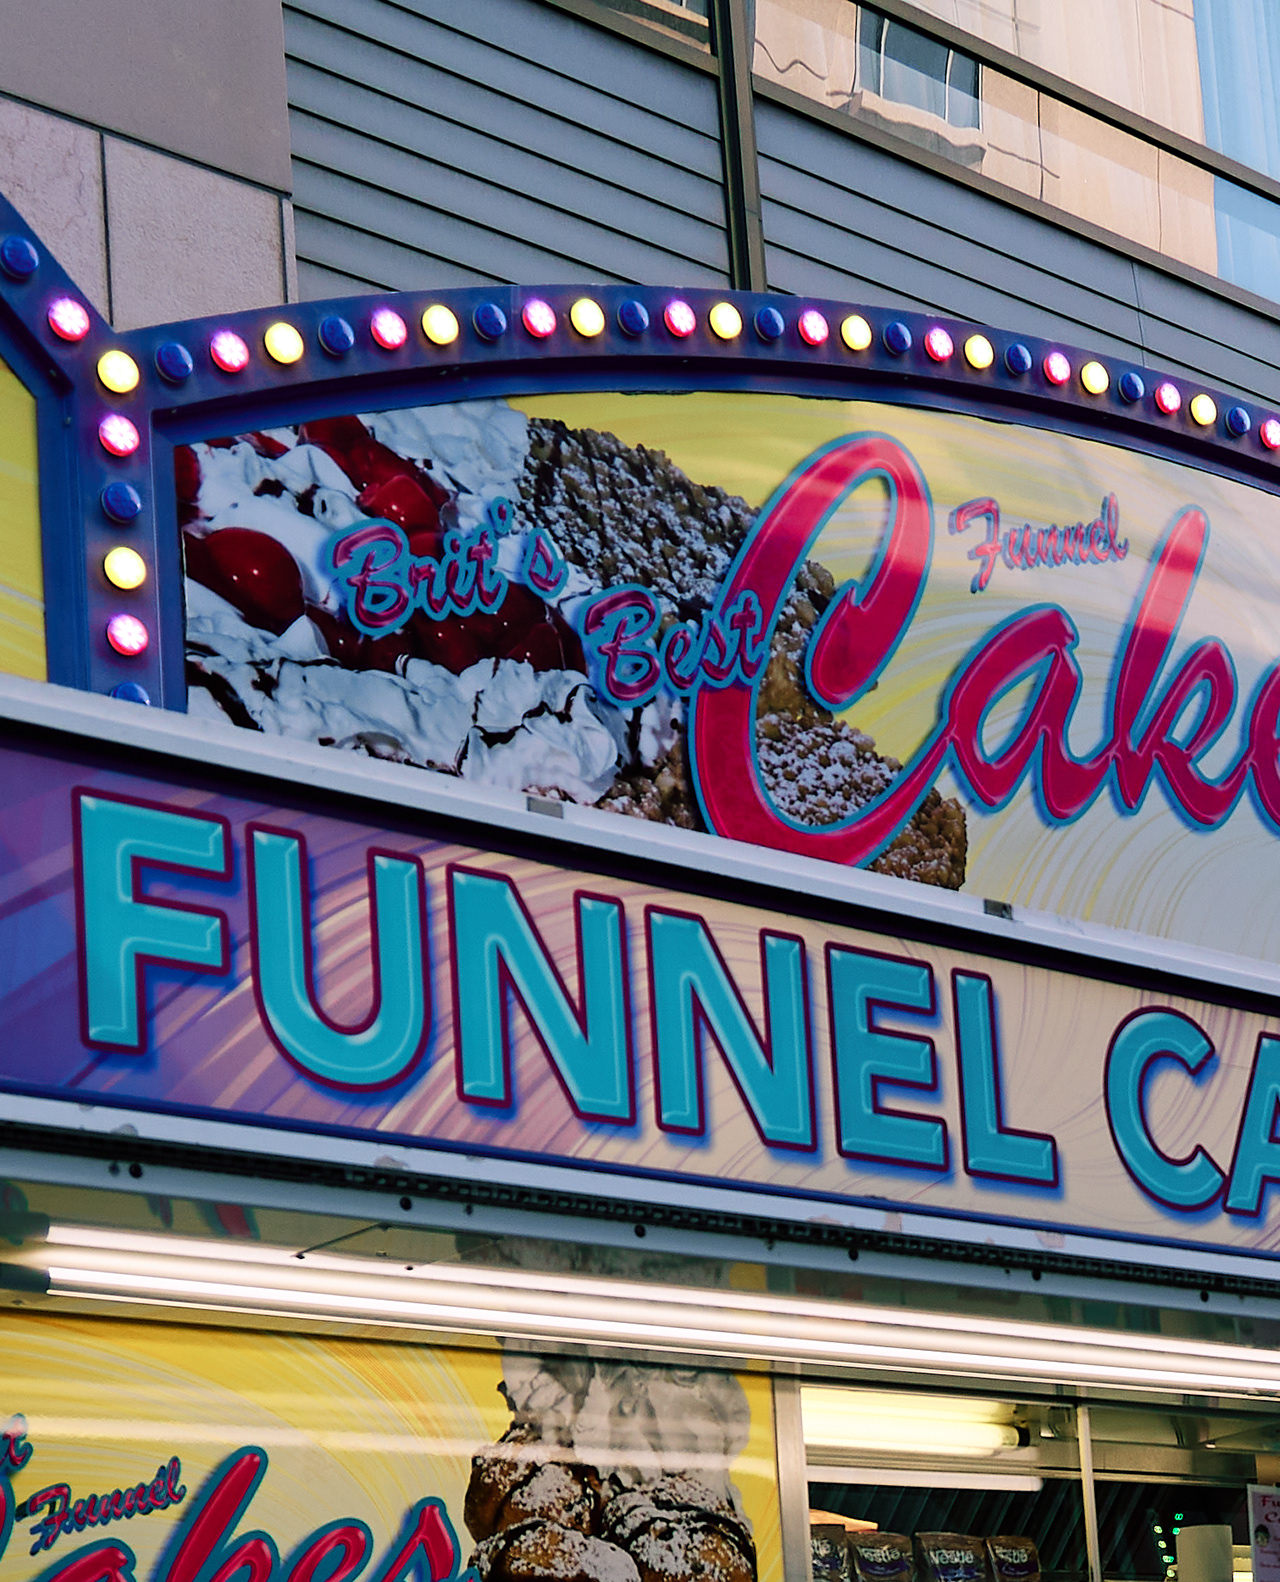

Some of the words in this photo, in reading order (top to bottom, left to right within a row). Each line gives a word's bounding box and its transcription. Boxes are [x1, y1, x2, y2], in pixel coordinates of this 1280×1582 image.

[332, 496, 568, 638] Brit's
[579, 584, 768, 708] Best
[948, 491, 1130, 594] Funnel
[70, 785, 1061, 1190] FUNNEL
[27, 1456, 187, 1557] Funnel
